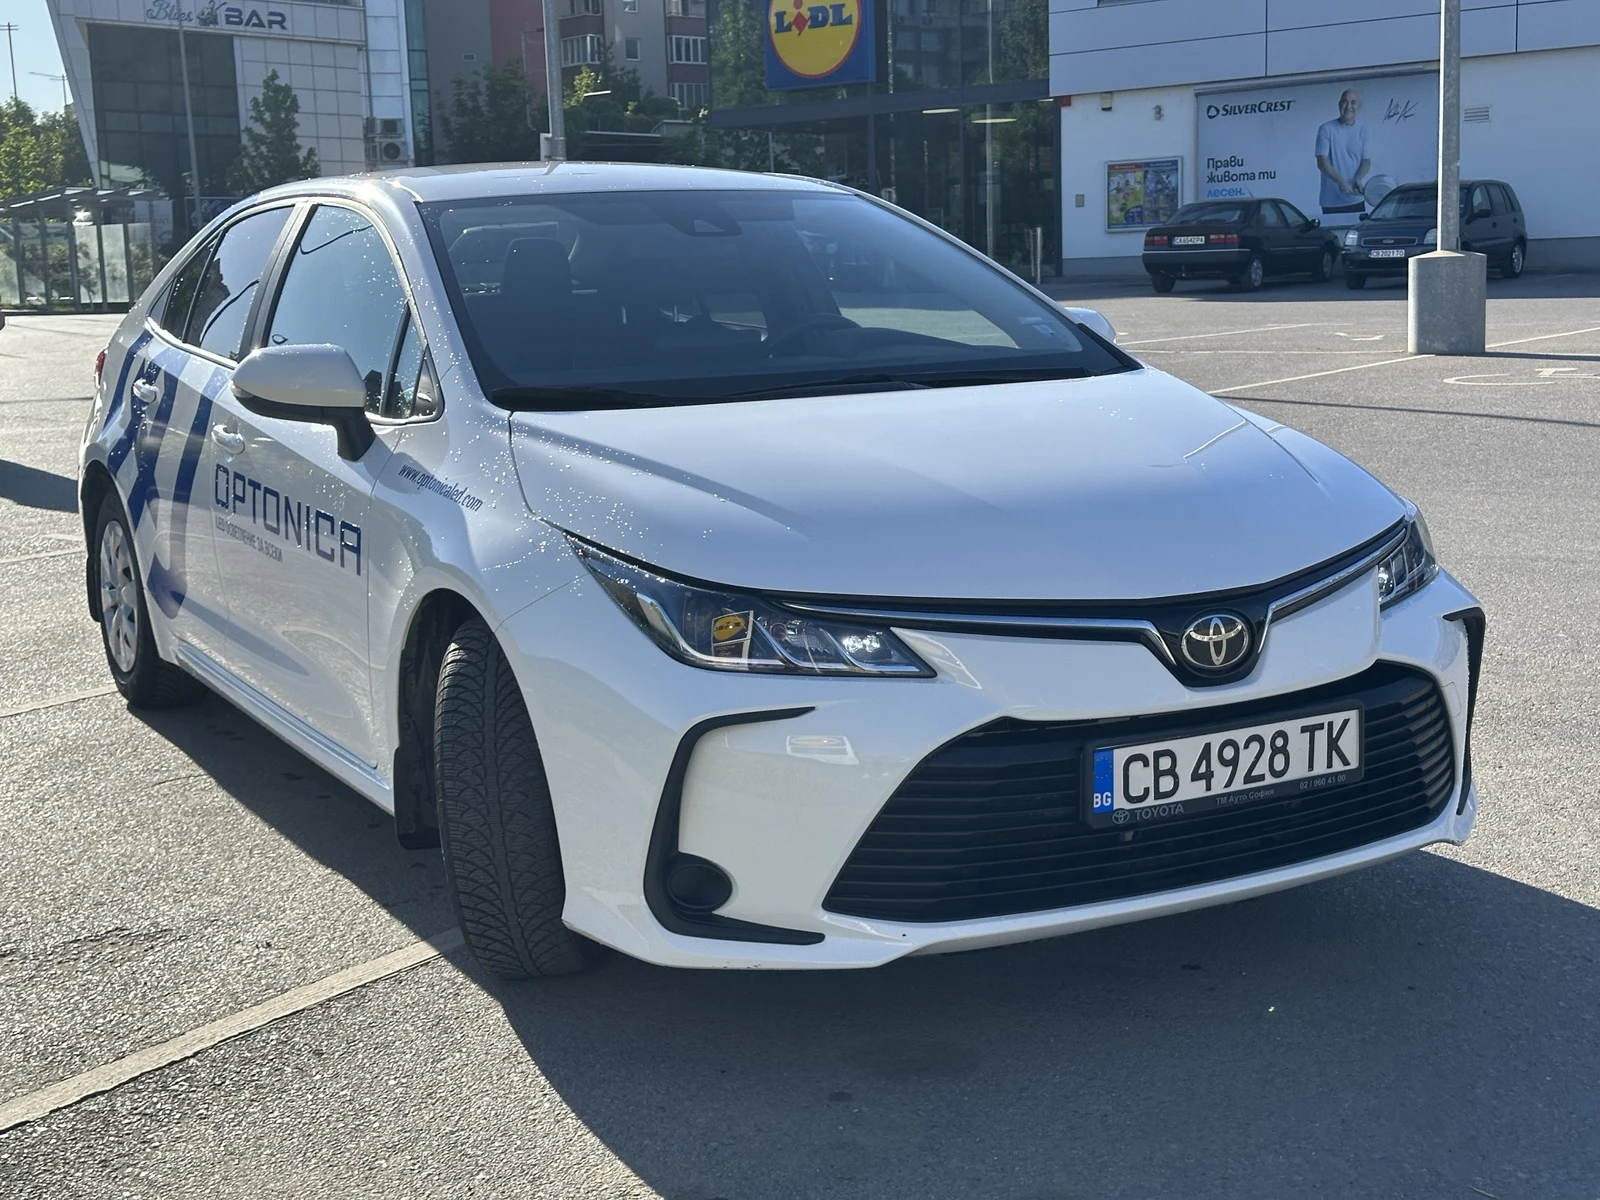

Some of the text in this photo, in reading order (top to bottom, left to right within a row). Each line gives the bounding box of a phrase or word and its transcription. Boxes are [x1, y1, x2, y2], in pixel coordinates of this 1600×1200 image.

[224, 7, 287, 30] BAR
[1206, 155, 1244, 171] Прави
[1206, 170, 1276, 184] живота ти
[1206, 187, 1245, 198] лесен.
[398, 464, 484, 512] www.optonicaled.com
[215, 463, 362, 576] OPTONICA
[1122, 718, 1351, 804] CB 4928 TK
[1093, 791, 1112, 808] BG
[1248, 788, 1275, 801] София
[1134, 803, 1185, 820] TOYOTA
